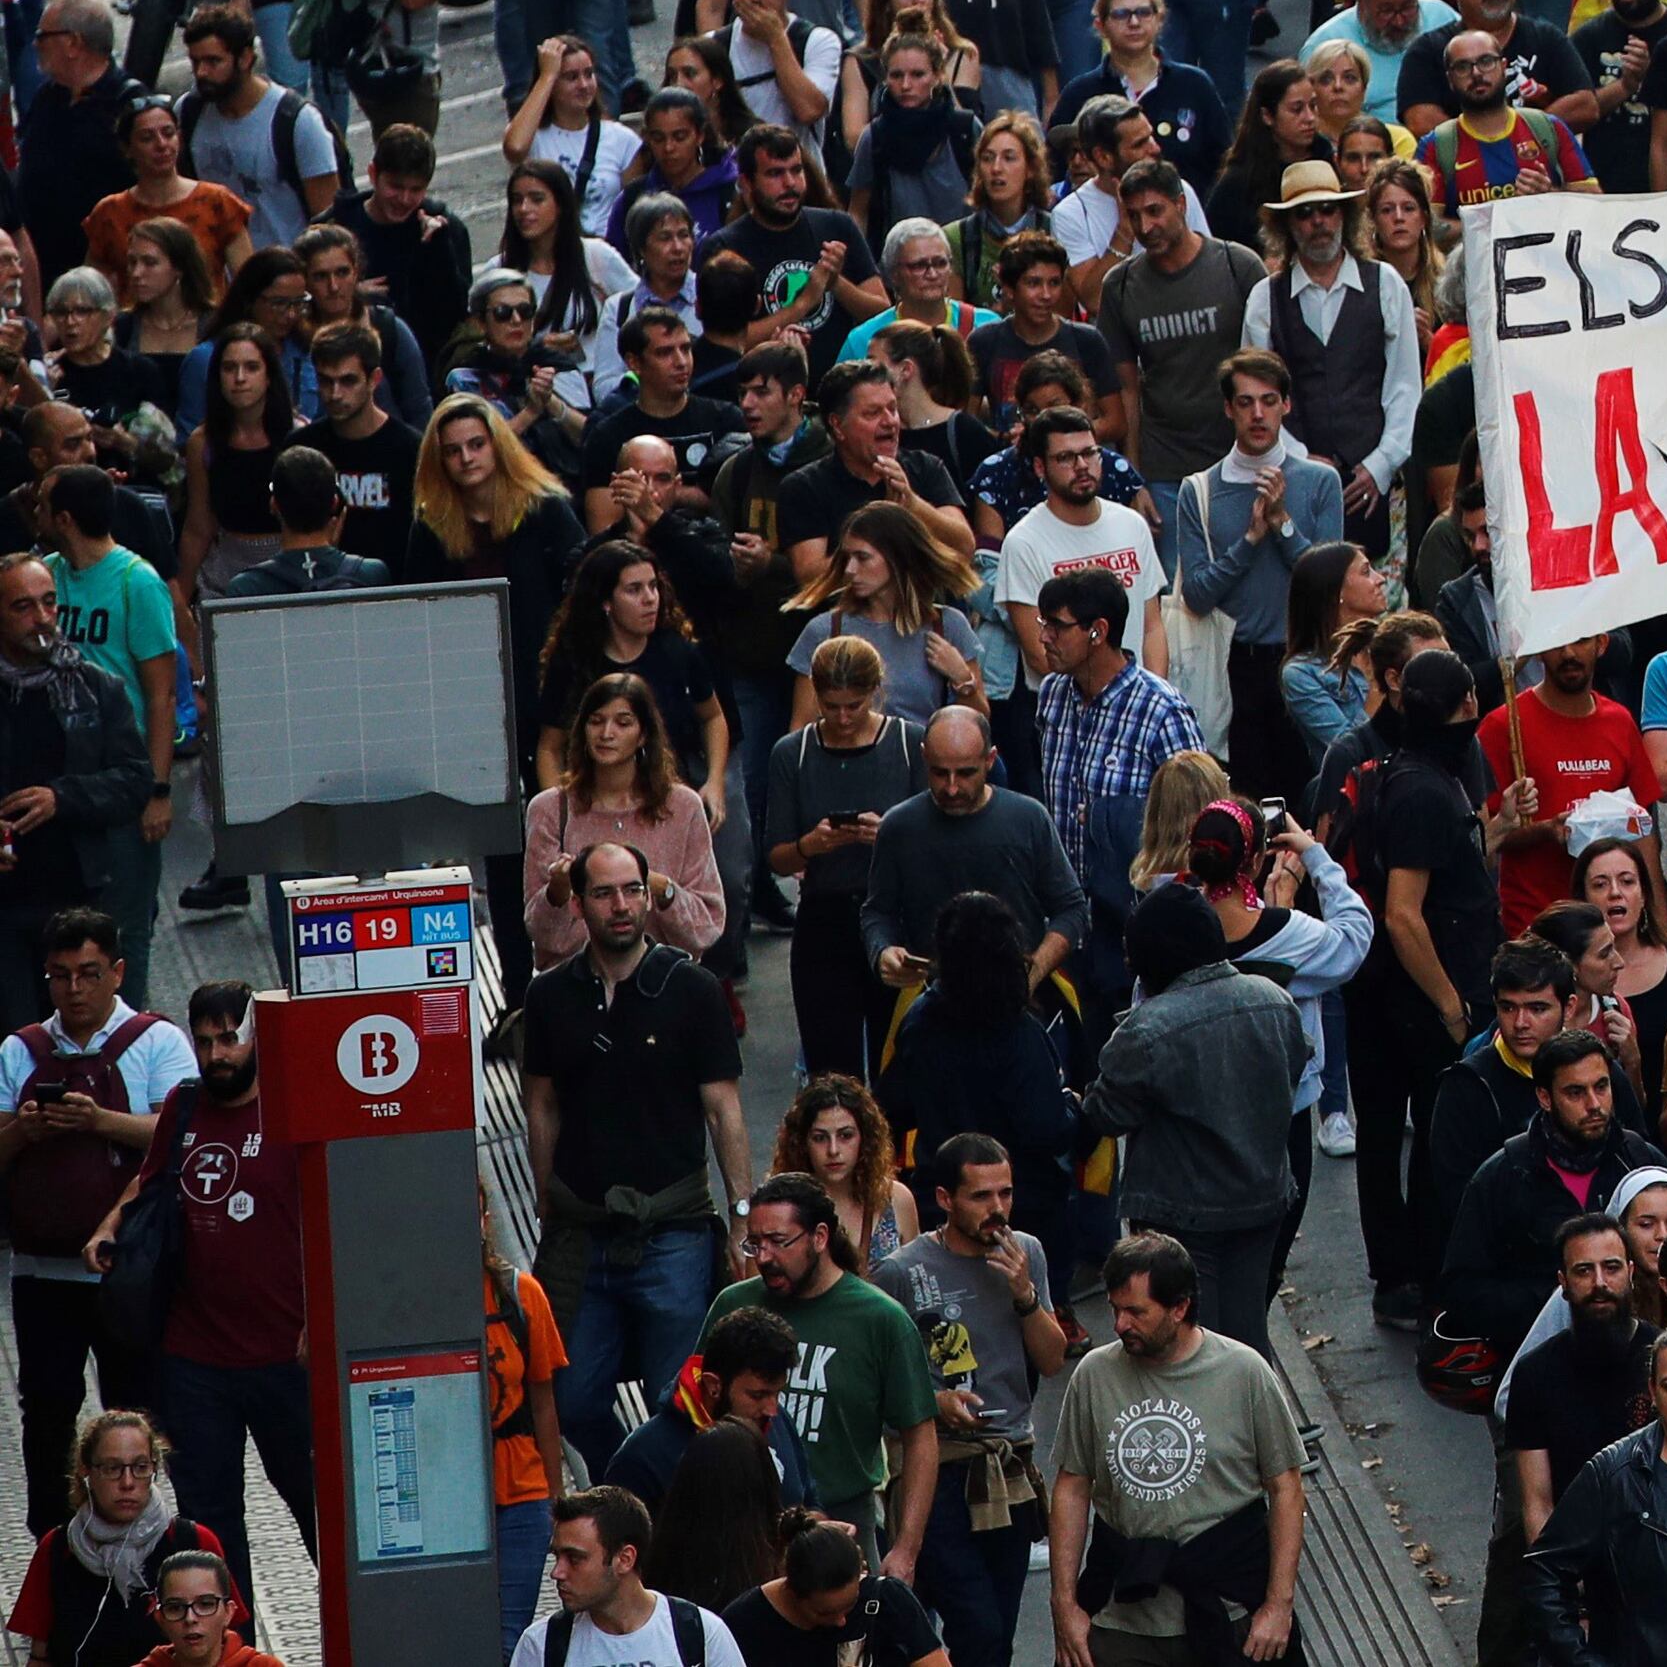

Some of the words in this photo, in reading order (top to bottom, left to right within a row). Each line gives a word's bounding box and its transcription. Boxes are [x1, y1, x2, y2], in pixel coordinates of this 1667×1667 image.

[1459, 182, 1516, 204] unice
[1140, 306, 1218, 343] ADDICT
[340, 473, 389, 507] RVEL
[1557, 759, 1611, 773] PULL&BEAR
[299, 921, 352, 947] H16
[365, 917, 397, 940] 19
[423, 911, 456, 933] N4
[1114, 1398, 1201, 1430] MOTARDS
[1106, 1447, 1207, 1502] INDEPENDENTISTES
